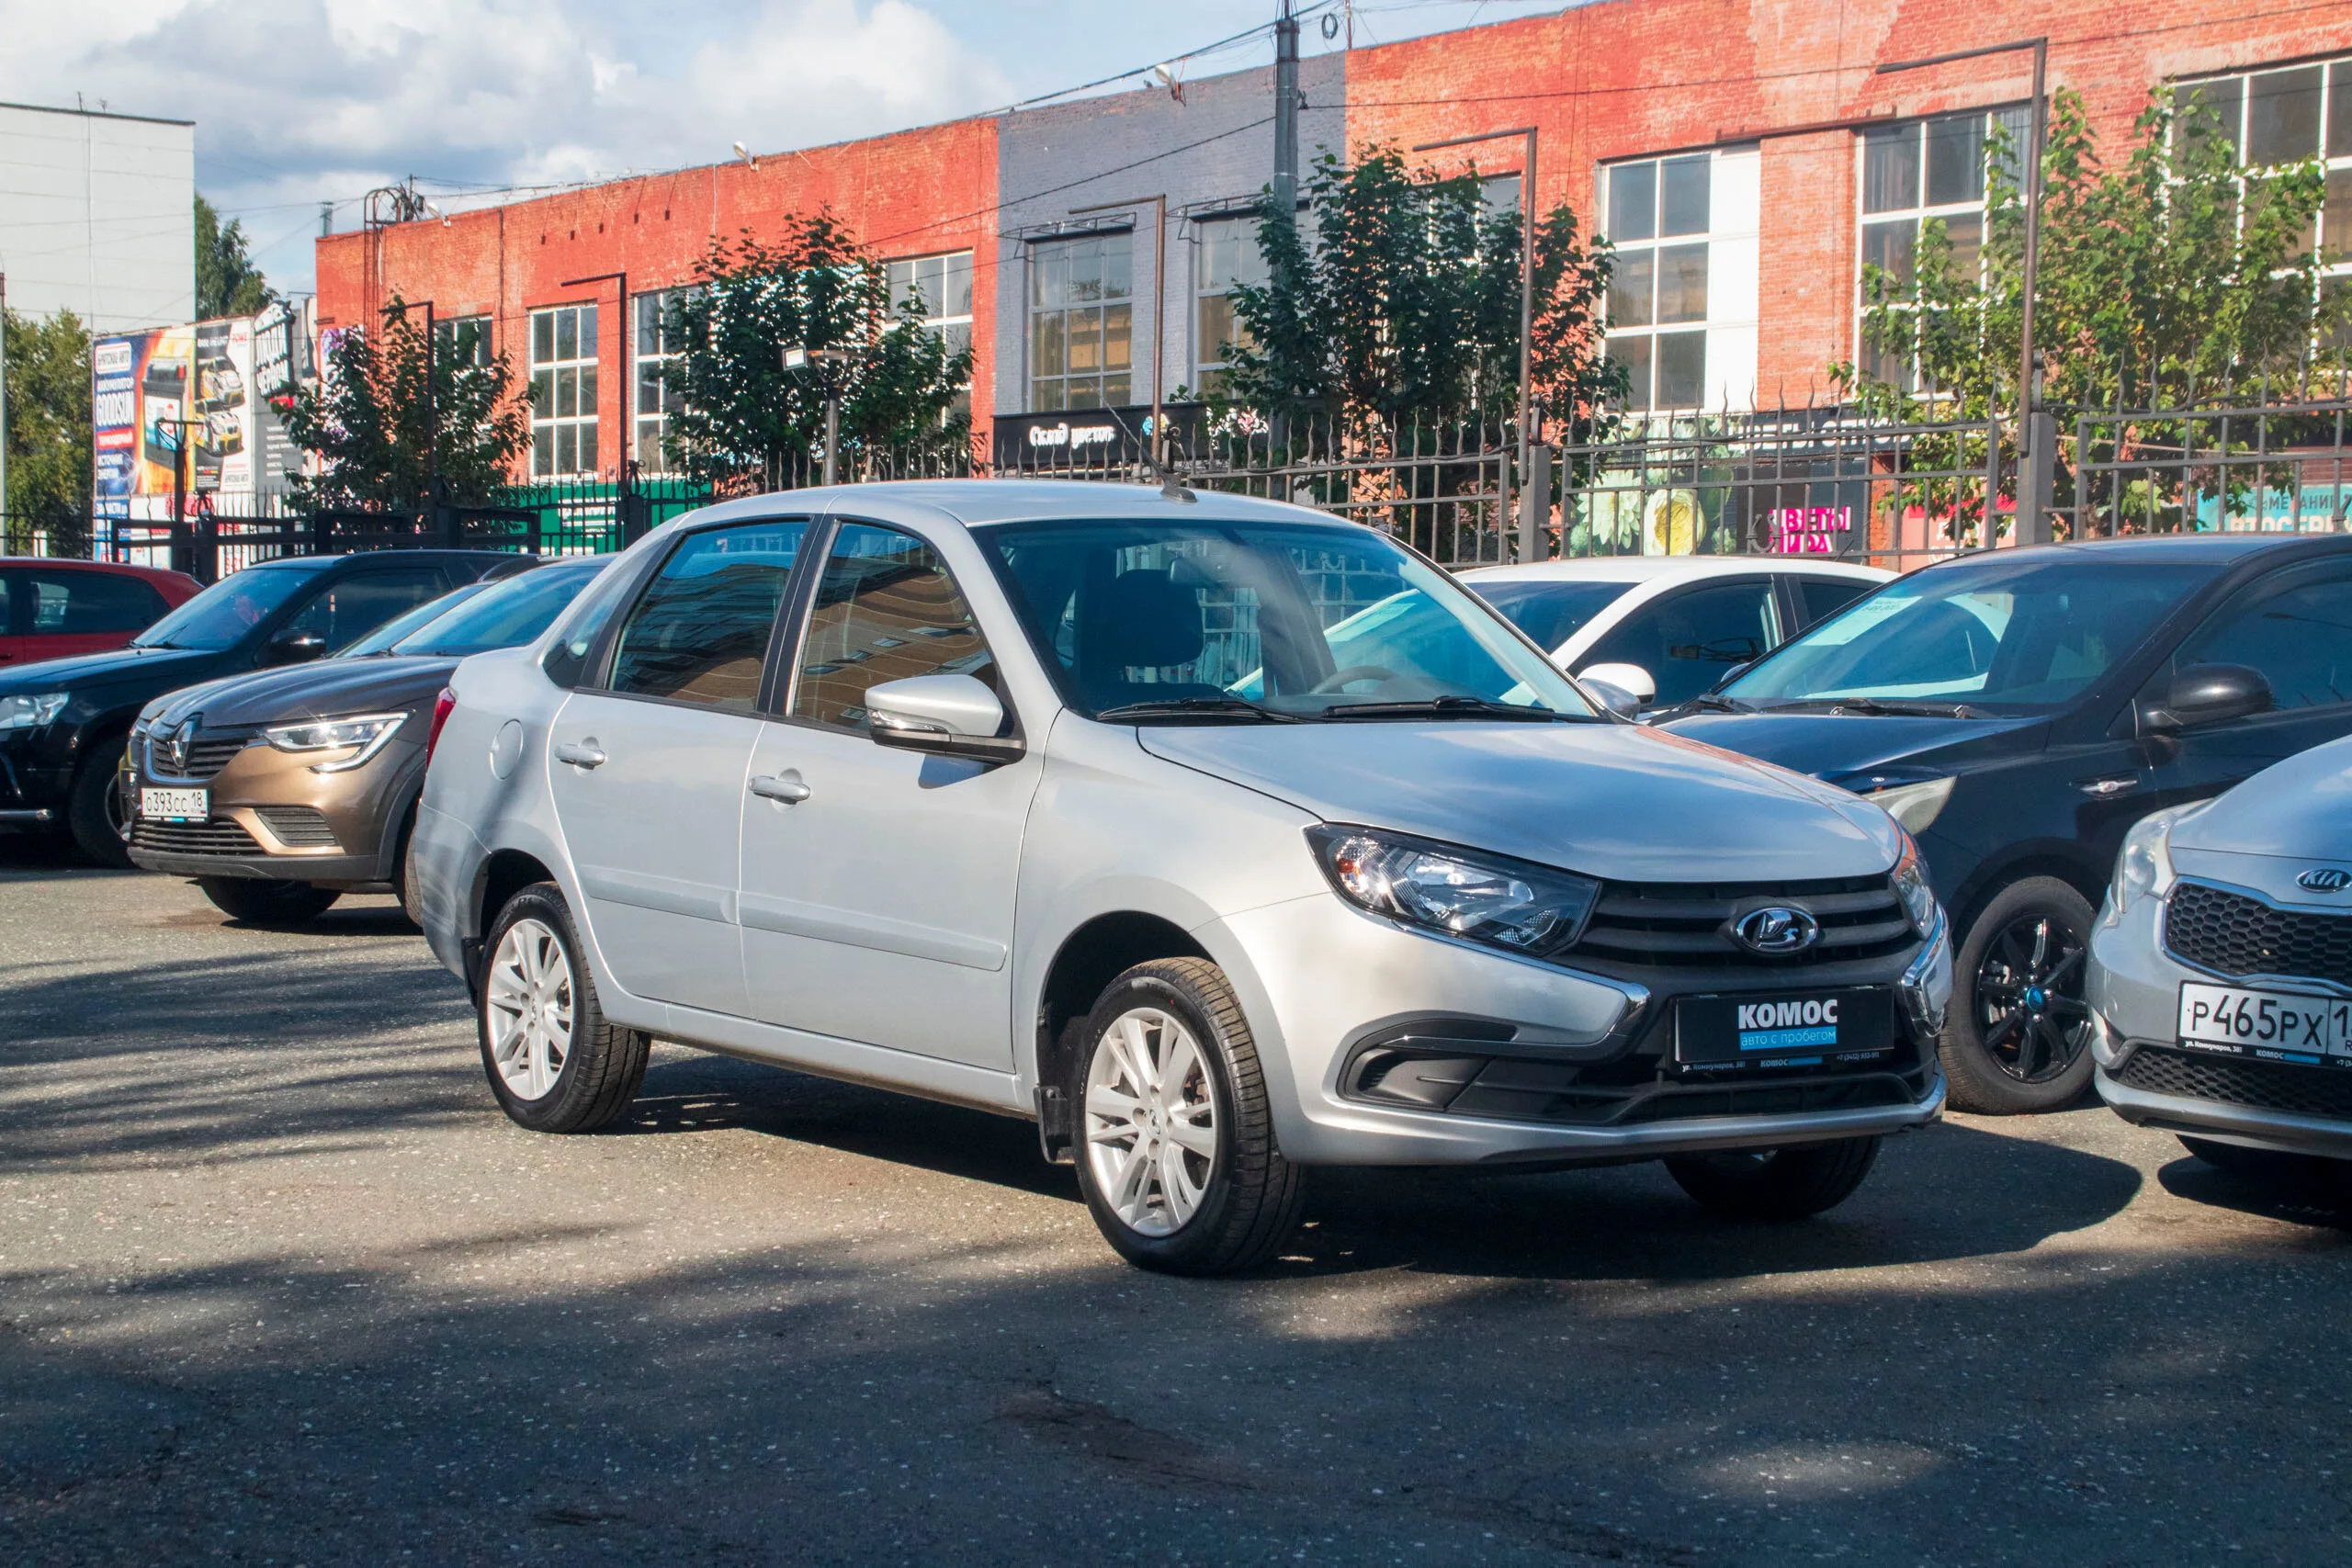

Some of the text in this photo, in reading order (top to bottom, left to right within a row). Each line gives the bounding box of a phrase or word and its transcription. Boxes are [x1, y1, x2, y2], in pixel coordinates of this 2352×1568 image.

[191, 791, 203, 807] 18
[2302, 871, 2342, 887] KIA
[1738, 998, 1838, 1030] КОМОС
[2192, 995, 2324, 1047] Р465РХ
[1741, 1030, 1836, 1047] авто с пробегом
